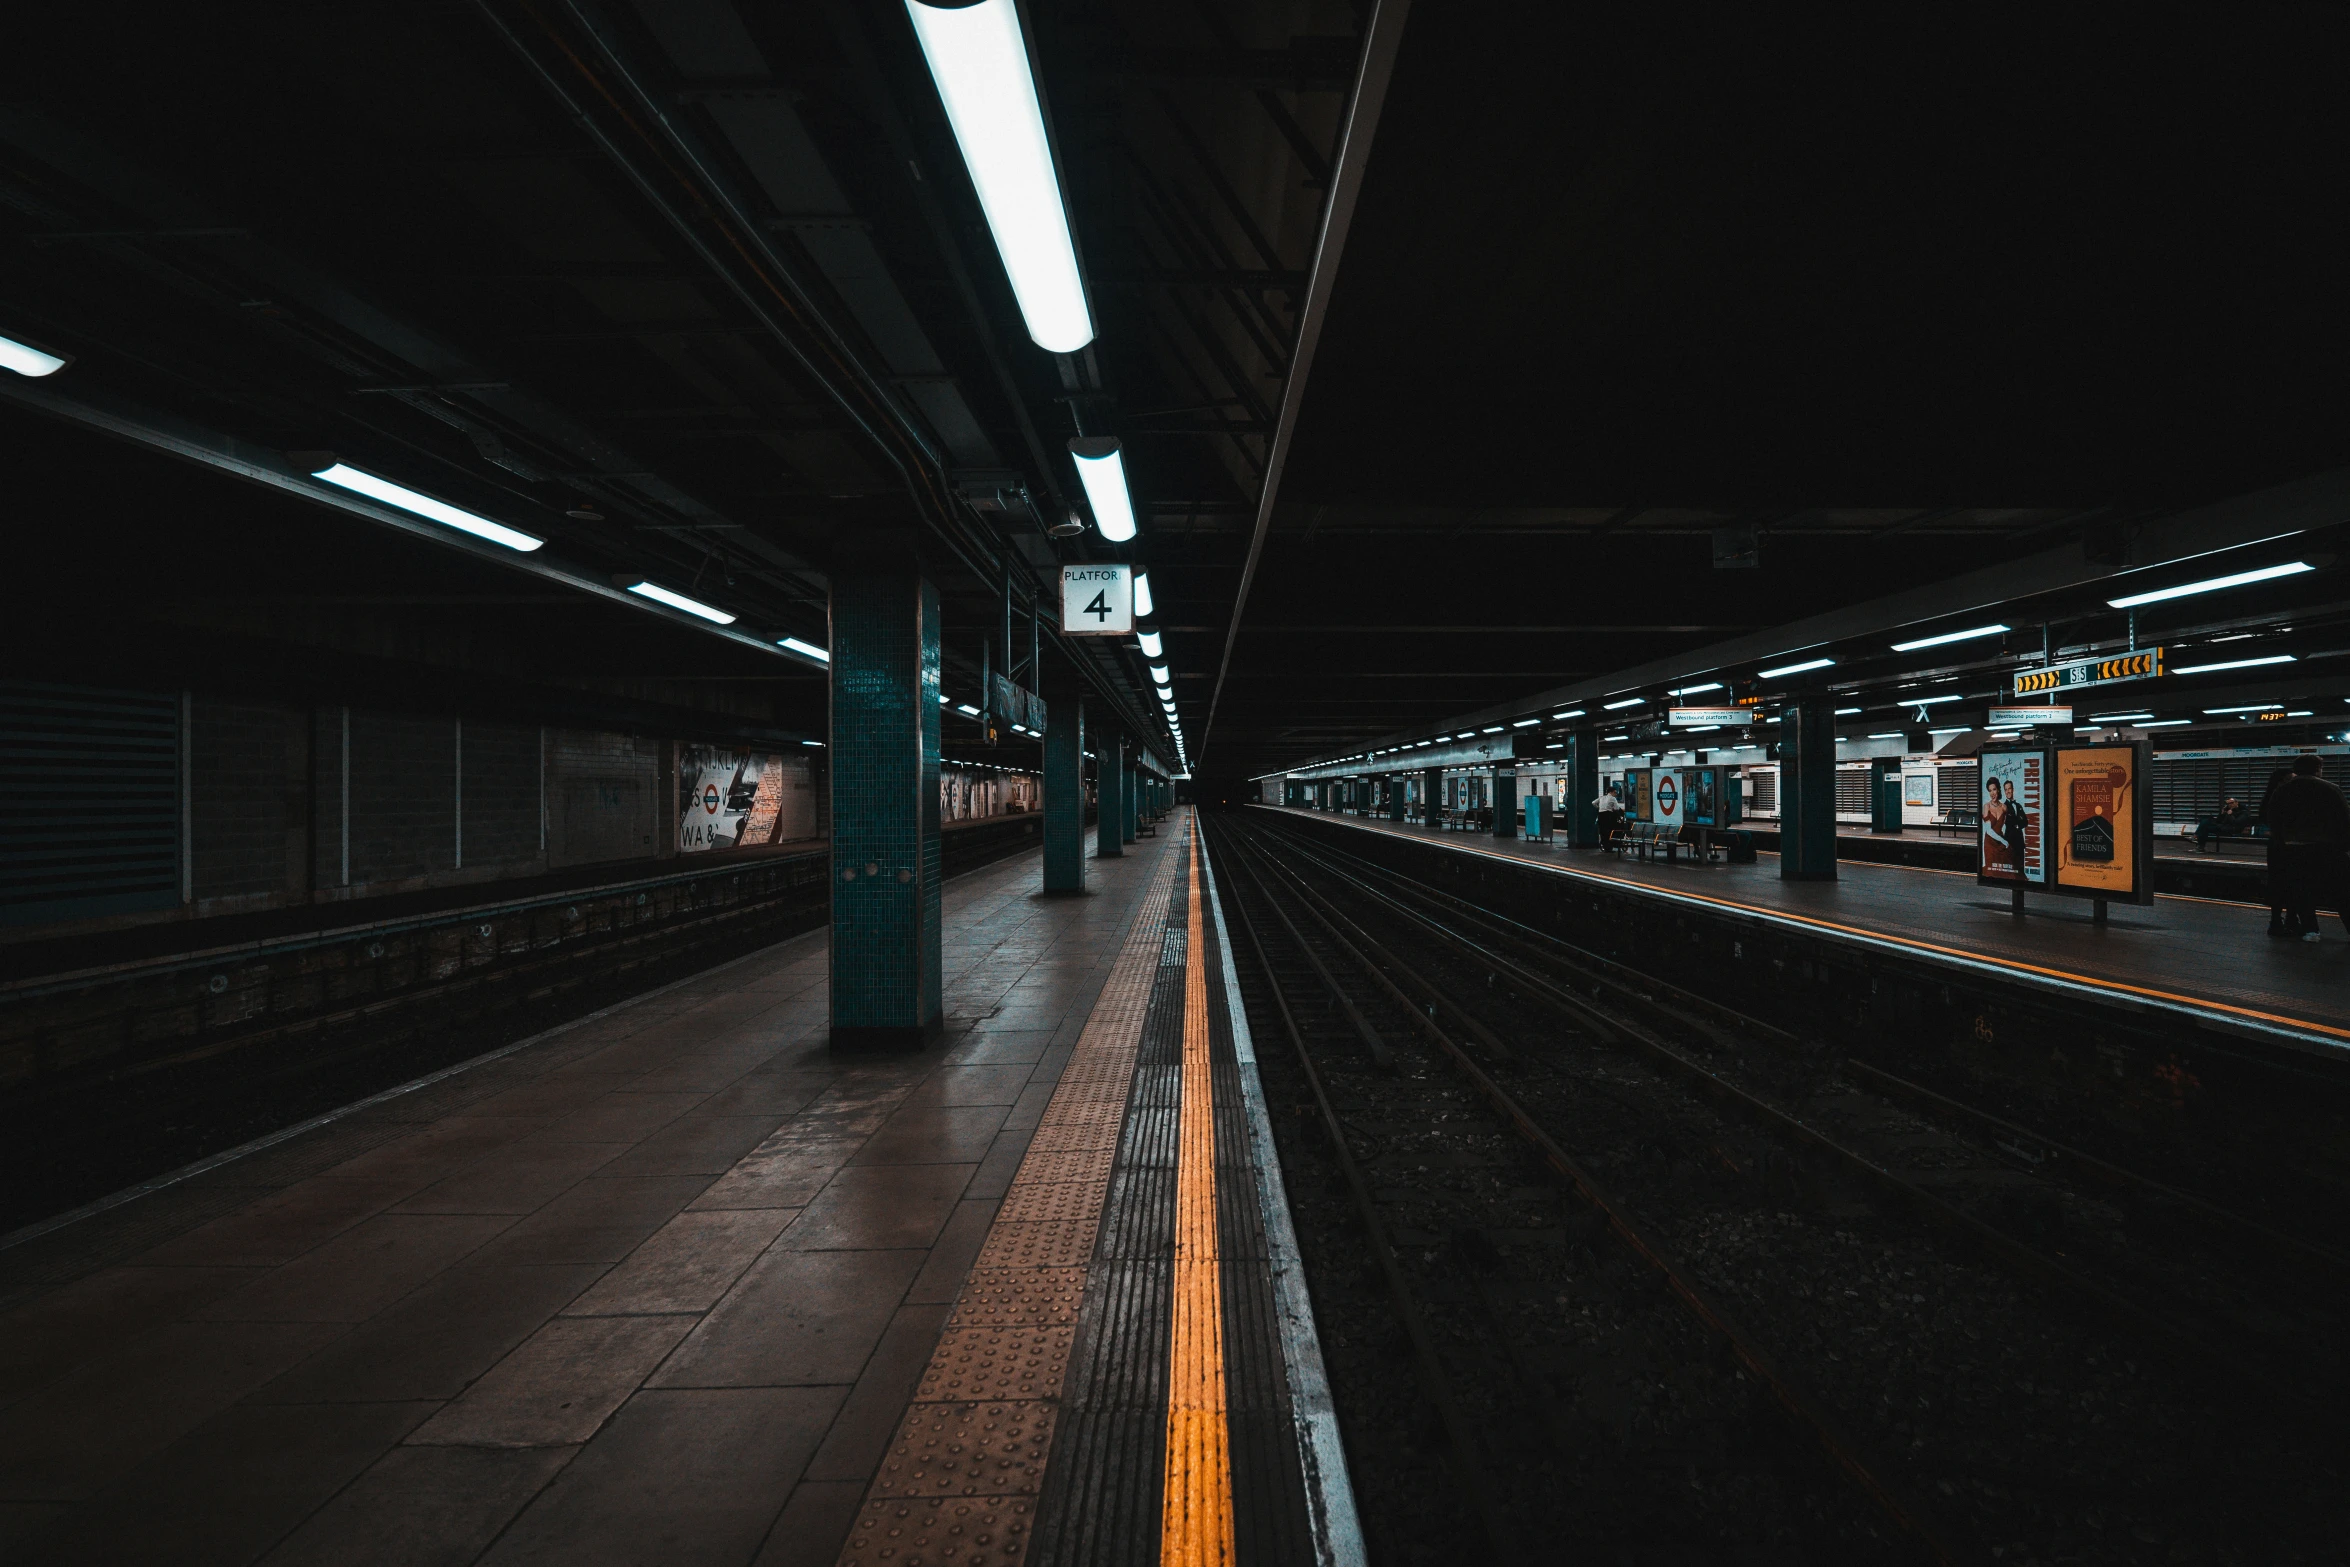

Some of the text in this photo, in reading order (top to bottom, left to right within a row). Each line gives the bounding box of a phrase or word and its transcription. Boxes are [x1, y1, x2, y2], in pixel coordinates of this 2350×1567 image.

[1064, 570, 1121, 581] PLATFOR
[1083, 588, 1112, 622] 4
[2024, 758, 2040, 809] PRETTY
[2076, 785, 2107, 793] KAMILA
[2076, 794, 2111, 803] SHAMSIE
[2024, 812, 2041, 867] WOMAN
[2076, 834, 2093, 842] BEST
[2076, 843, 2107, 852] FRIENDS
